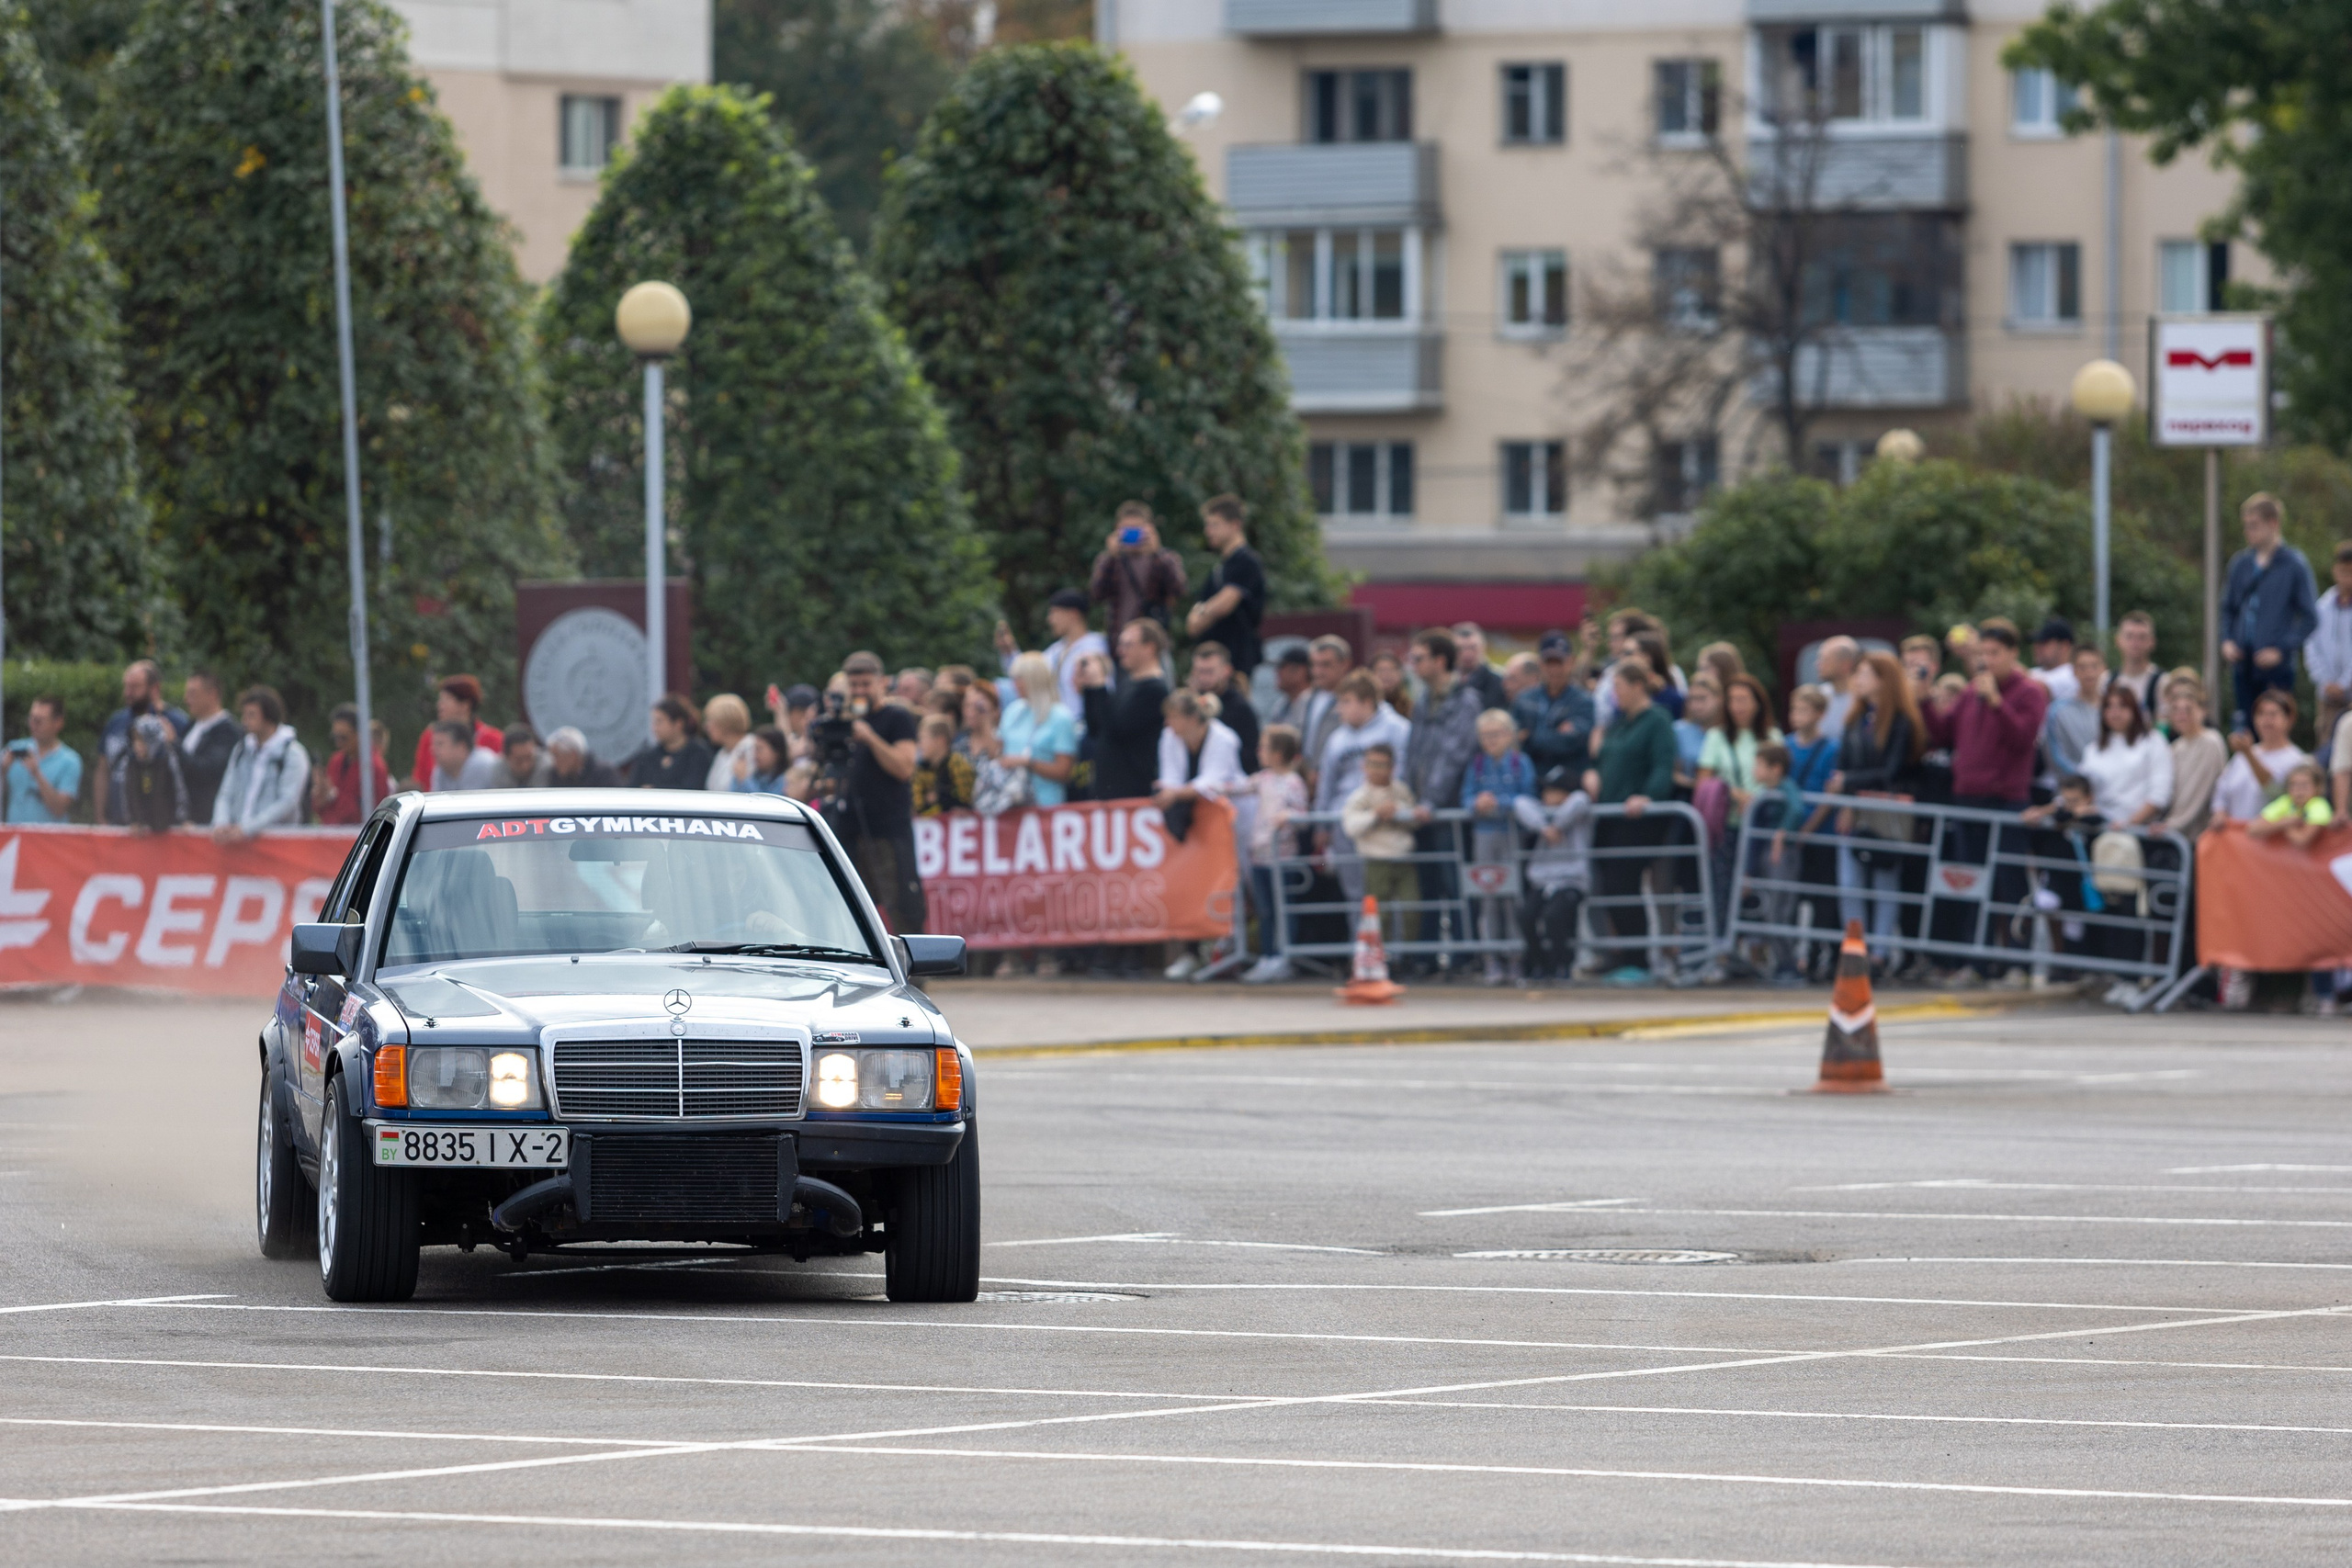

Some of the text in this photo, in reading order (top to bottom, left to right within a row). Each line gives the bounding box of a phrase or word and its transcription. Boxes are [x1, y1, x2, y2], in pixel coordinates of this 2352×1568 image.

[912, 807, 1166, 878] BELARUS
[923, 872, 1170, 936] TRACTORS
[381, 1148, 398, 1160] BY
[404, 1132, 476, 1161] 8835
